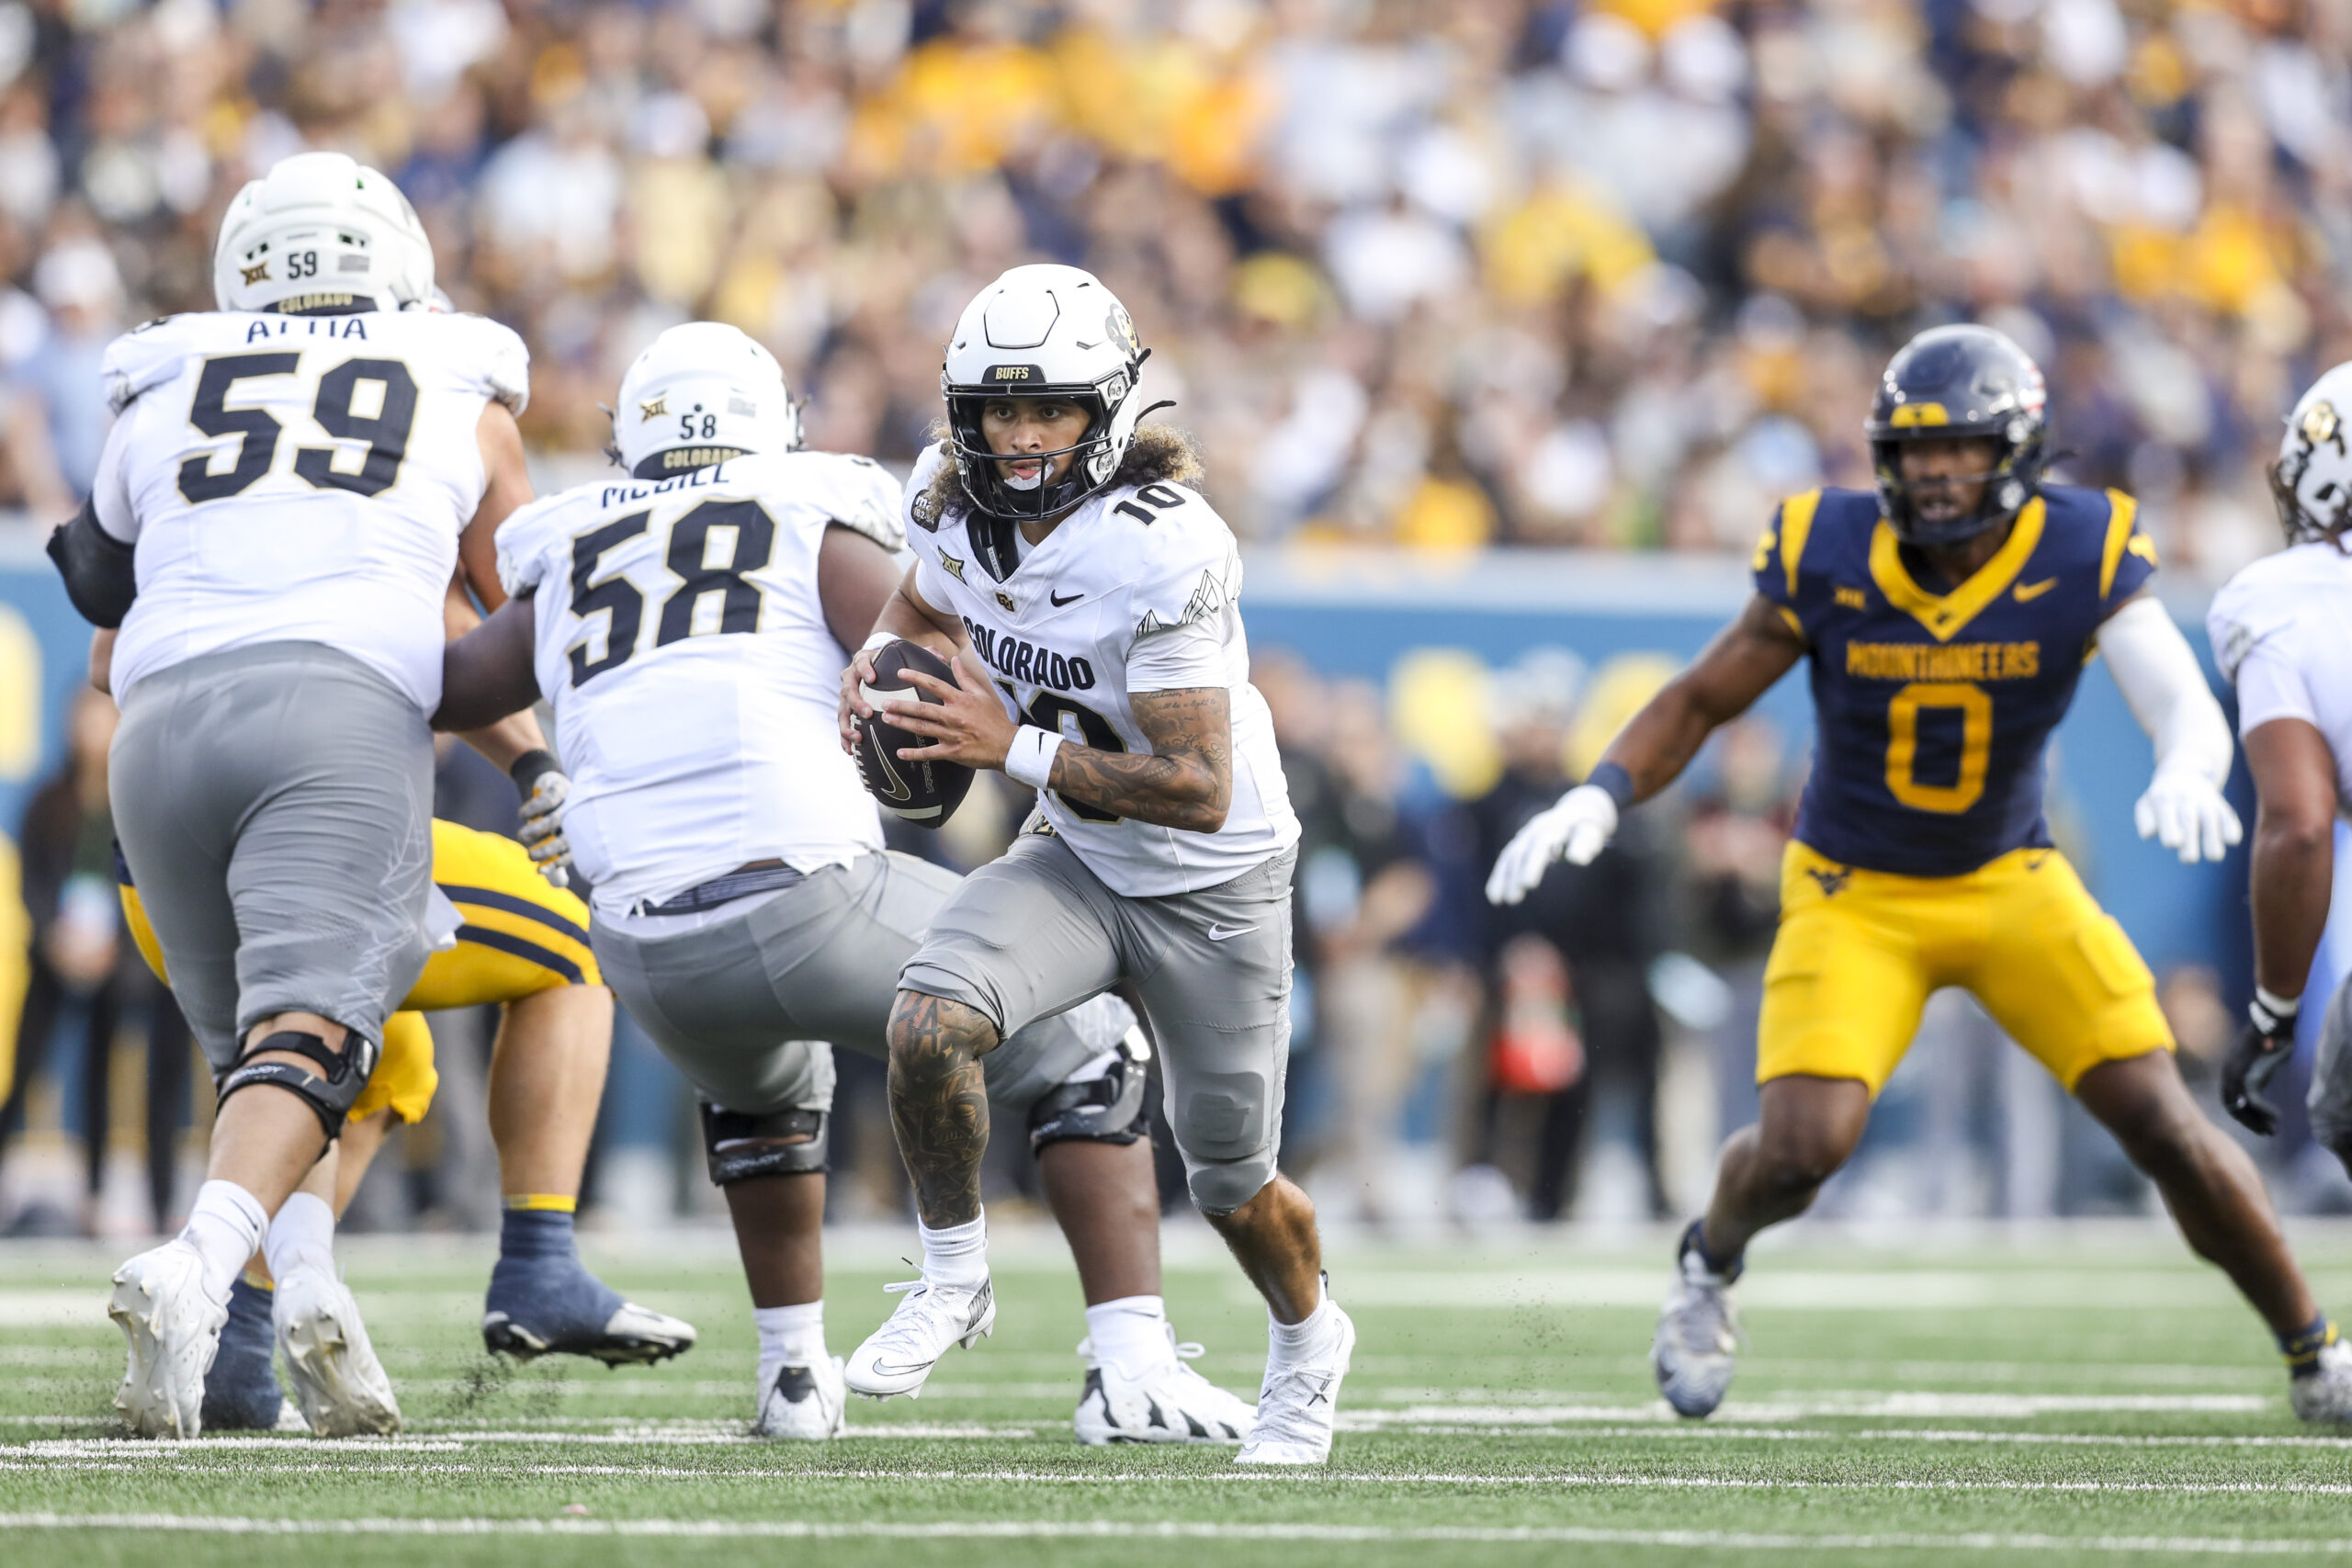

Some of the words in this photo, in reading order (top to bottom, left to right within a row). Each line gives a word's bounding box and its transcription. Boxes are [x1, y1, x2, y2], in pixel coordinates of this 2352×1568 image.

[288, 251, 317, 279] 59
[995, 367, 1029, 380] BUFFS
[176, 349, 420, 506] 59
[680, 414, 717, 439] 58
[1111, 483, 1186, 528] 10
[567, 495, 779, 689] 58
[963, 615, 1095, 691] COLORADO
[1886, 682, 1994, 815] 0
